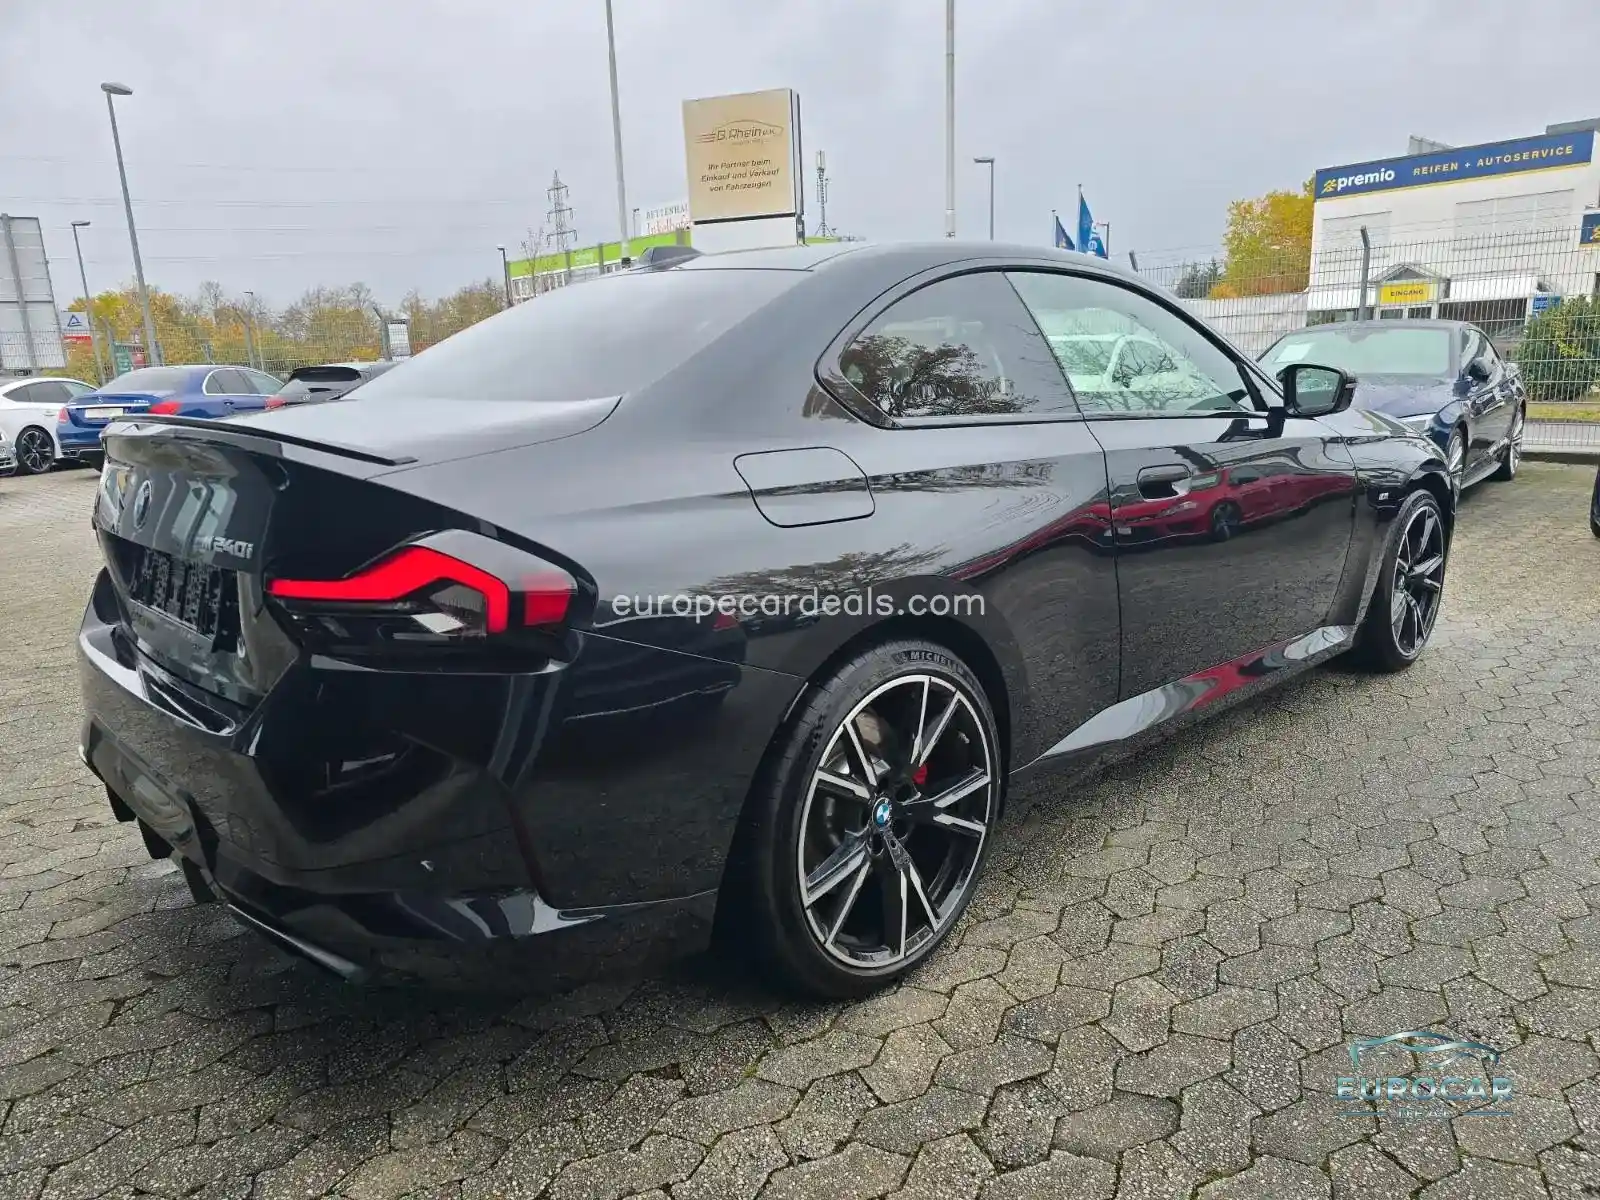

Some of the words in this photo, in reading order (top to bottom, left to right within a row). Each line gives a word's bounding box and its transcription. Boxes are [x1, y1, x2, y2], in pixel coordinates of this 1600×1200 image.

[721, 160, 750, 170] Partner
[752, 158, 771, 167] beim
[1413, 161, 1459, 176] REIFEN
[1477, 144, 1574, 167] AUTOSERVICE
[701, 173, 731, 183] Einkauf
[732, 171, 747, 180] und
[749, 168, 780, 178] Verkauf
[1337, 168, 1396, 192] premio
[725, 180, 772, 192] Fahrzeugen
[1390, 289, 1424, 297] EINGANG
